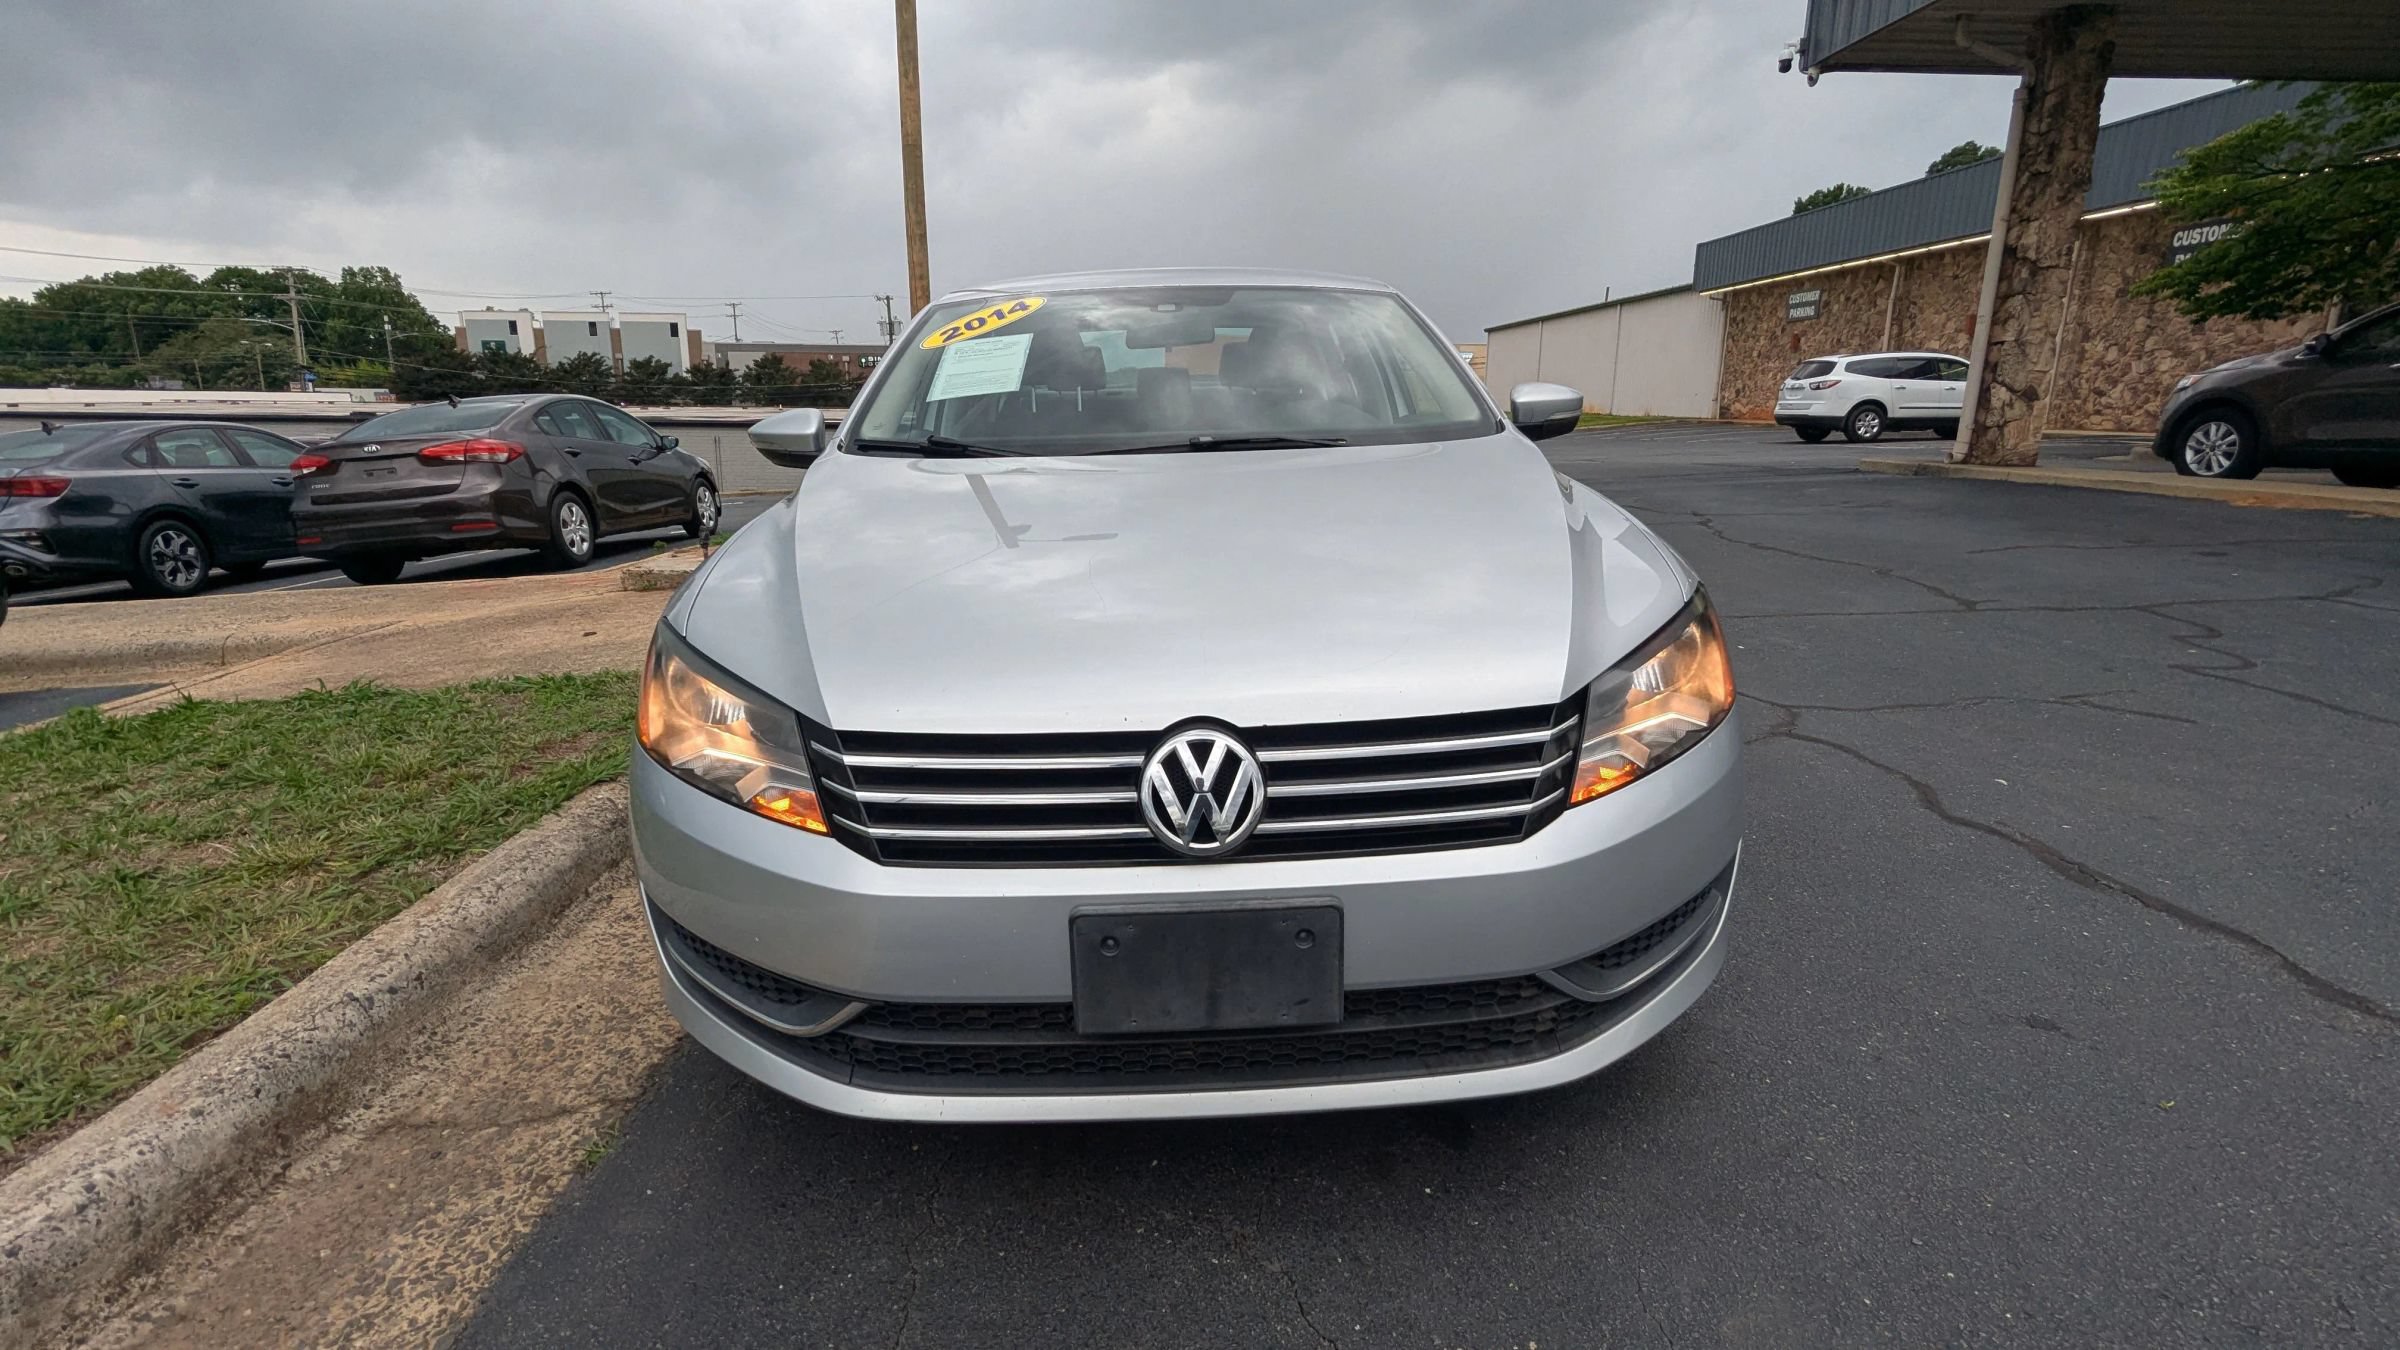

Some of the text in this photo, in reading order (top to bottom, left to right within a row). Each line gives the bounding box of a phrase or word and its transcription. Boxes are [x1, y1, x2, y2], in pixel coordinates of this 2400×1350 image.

[1789, 290, 1820, 304] CUSTOMER
[1789, 305, 1815, 319] PARKING
[939, 300, 1032, 344] 2014
[363, 445, 379, 453] KIA
